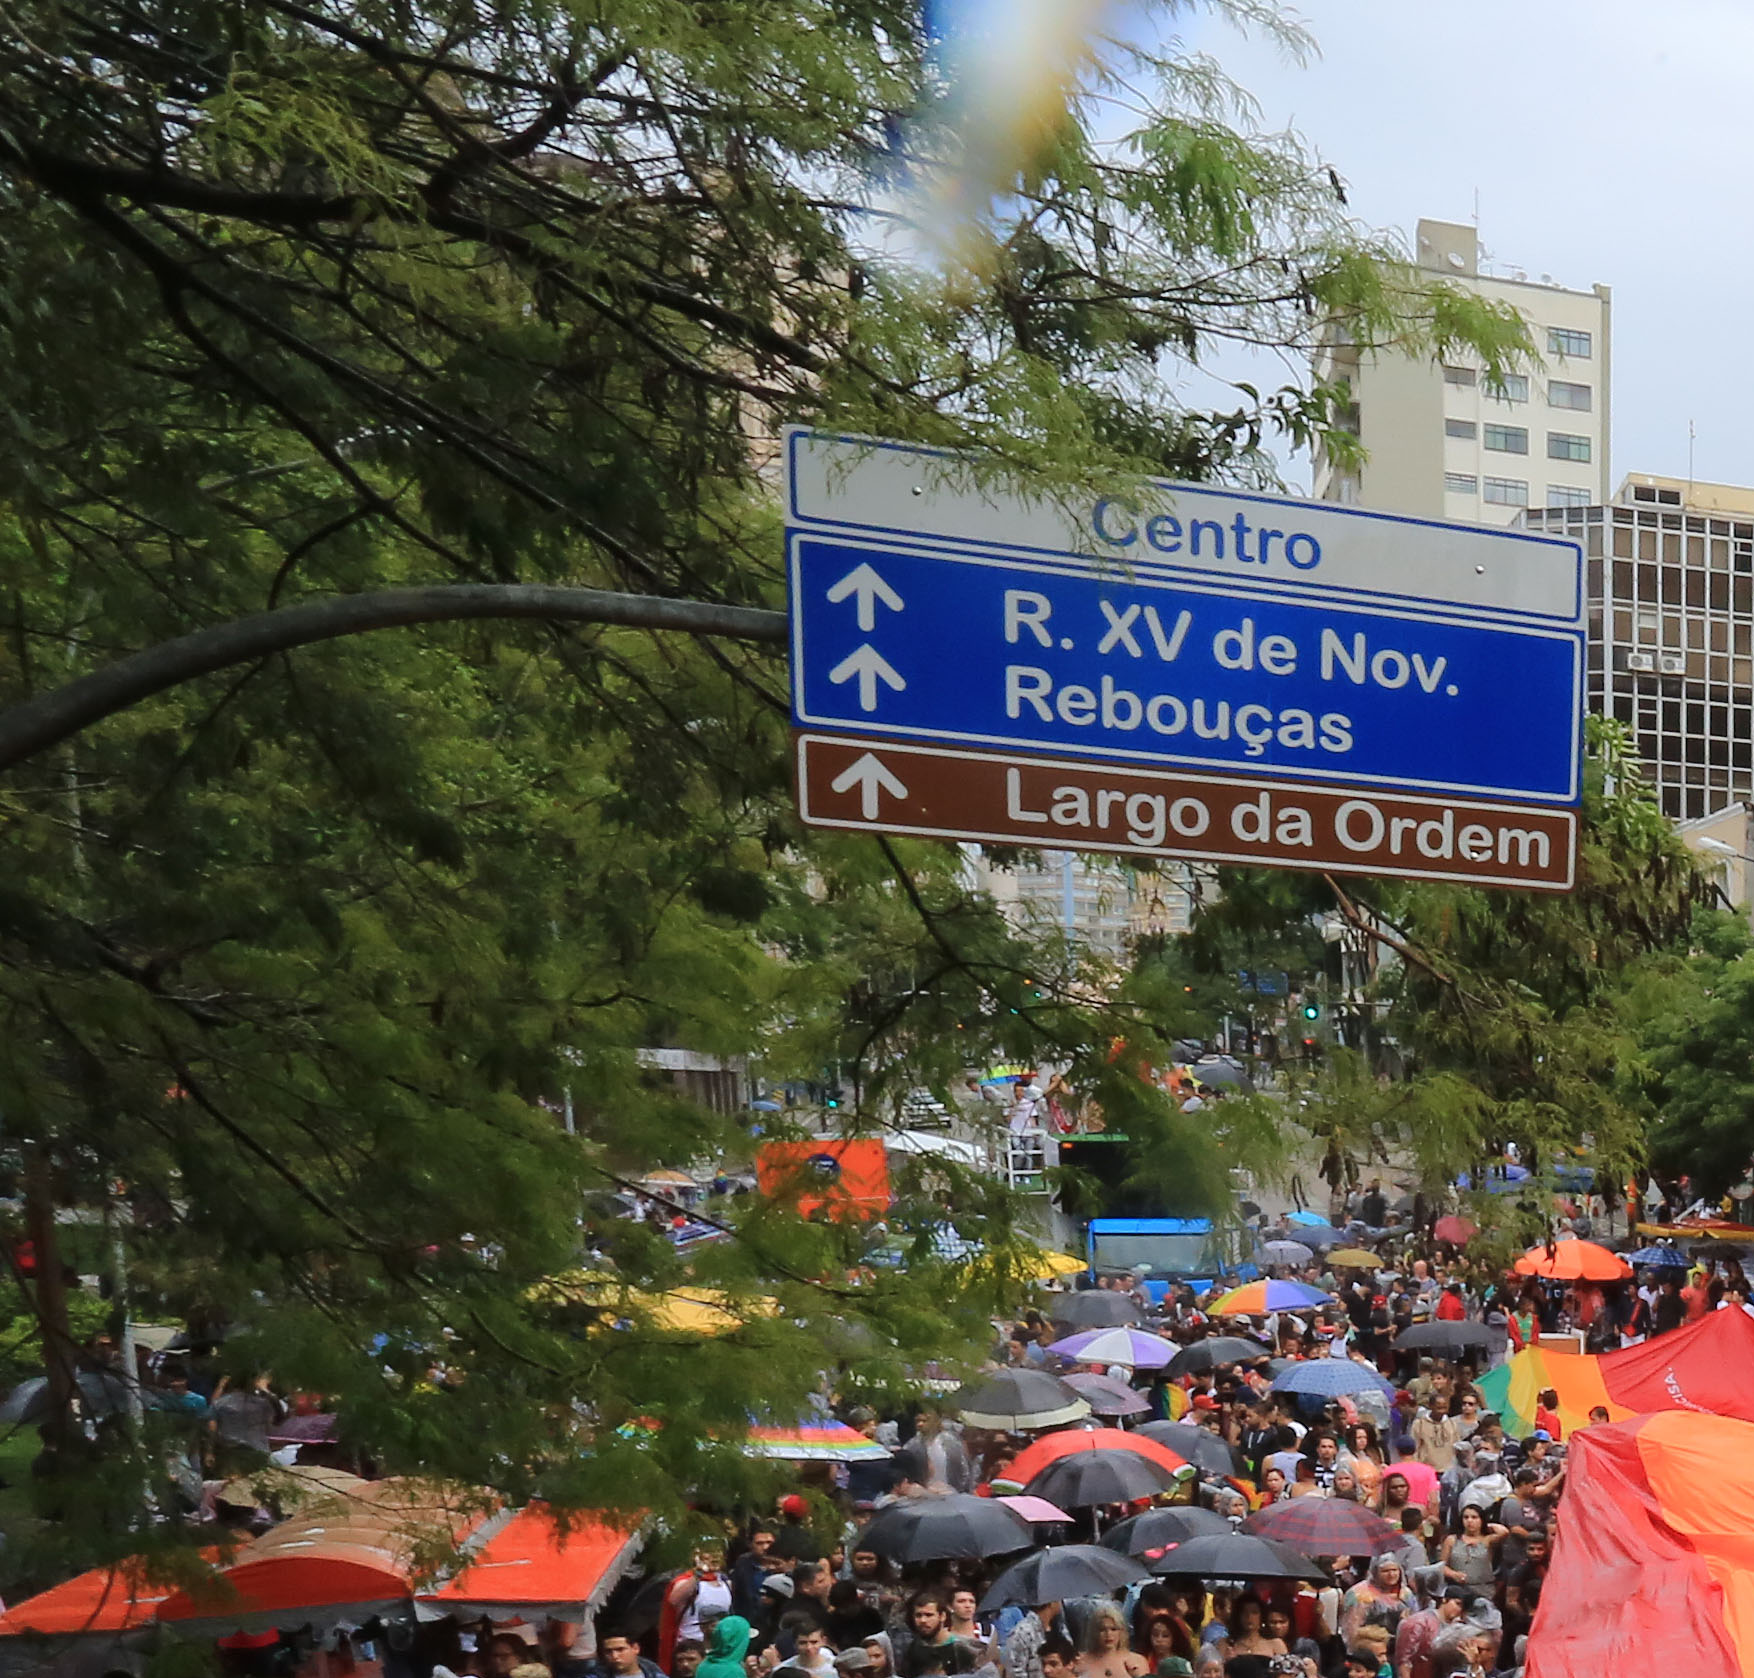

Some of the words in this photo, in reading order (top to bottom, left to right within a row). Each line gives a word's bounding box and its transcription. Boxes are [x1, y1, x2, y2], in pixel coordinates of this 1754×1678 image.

[1091, 495, 1322, 572] Centro
[1003, 588, 1075, 651] R.
[1097, 600, 1193, 661] XV
[1213, 616, 1298, 675] de
[1319, 627, 1460, 697] Nov.
[1004, 665, 1355, 757] Rebouças
[1006, 768, 1211, 848] Largo
[1231, 791, 1315, 849] da
[1334, 799, 1551, 869] Ordem
